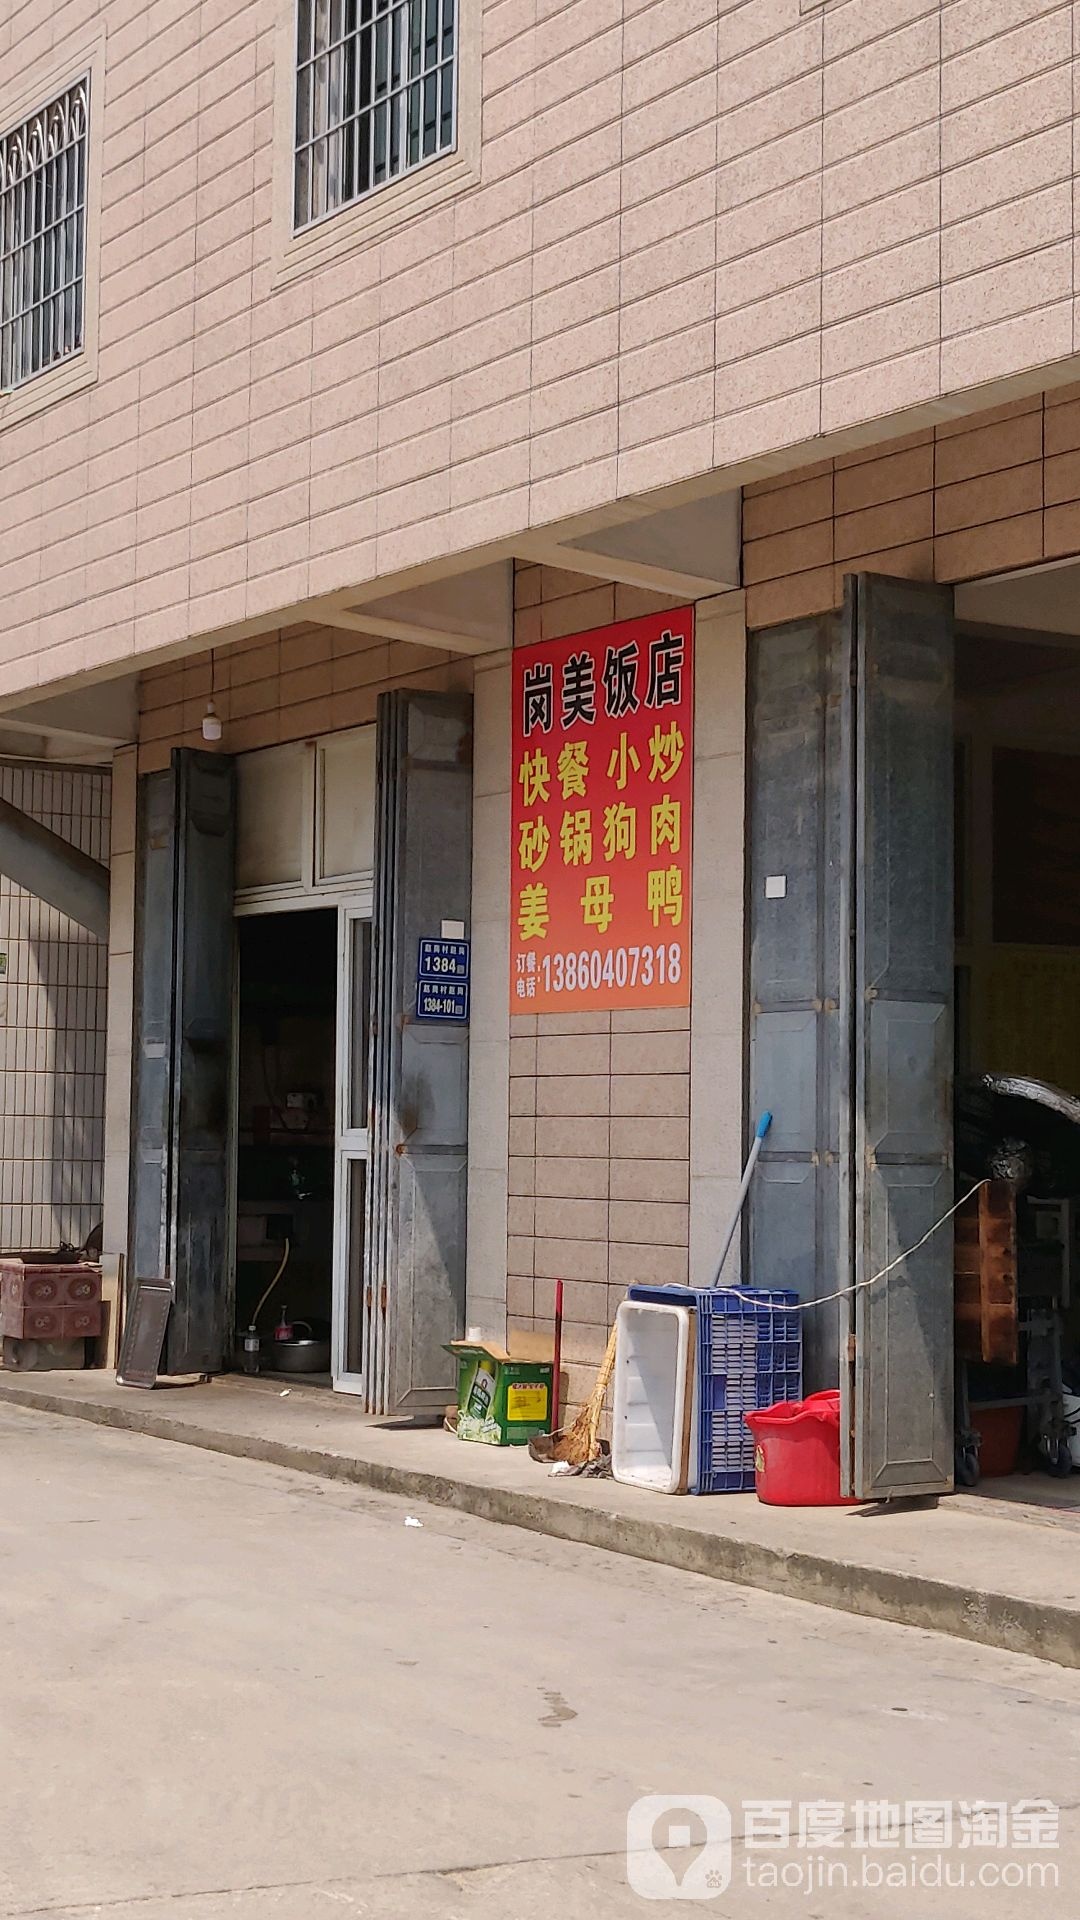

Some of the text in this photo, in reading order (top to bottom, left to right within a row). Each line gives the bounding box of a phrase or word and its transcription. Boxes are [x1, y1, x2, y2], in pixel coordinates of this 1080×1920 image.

[523, 630, 685, 737] 岗美饭店
[518, 794, 681, 873] 砂锅狗肉
[517, 864, 683, 941] 姜母鸭
[542, 943, 682, 992] 13860407318
